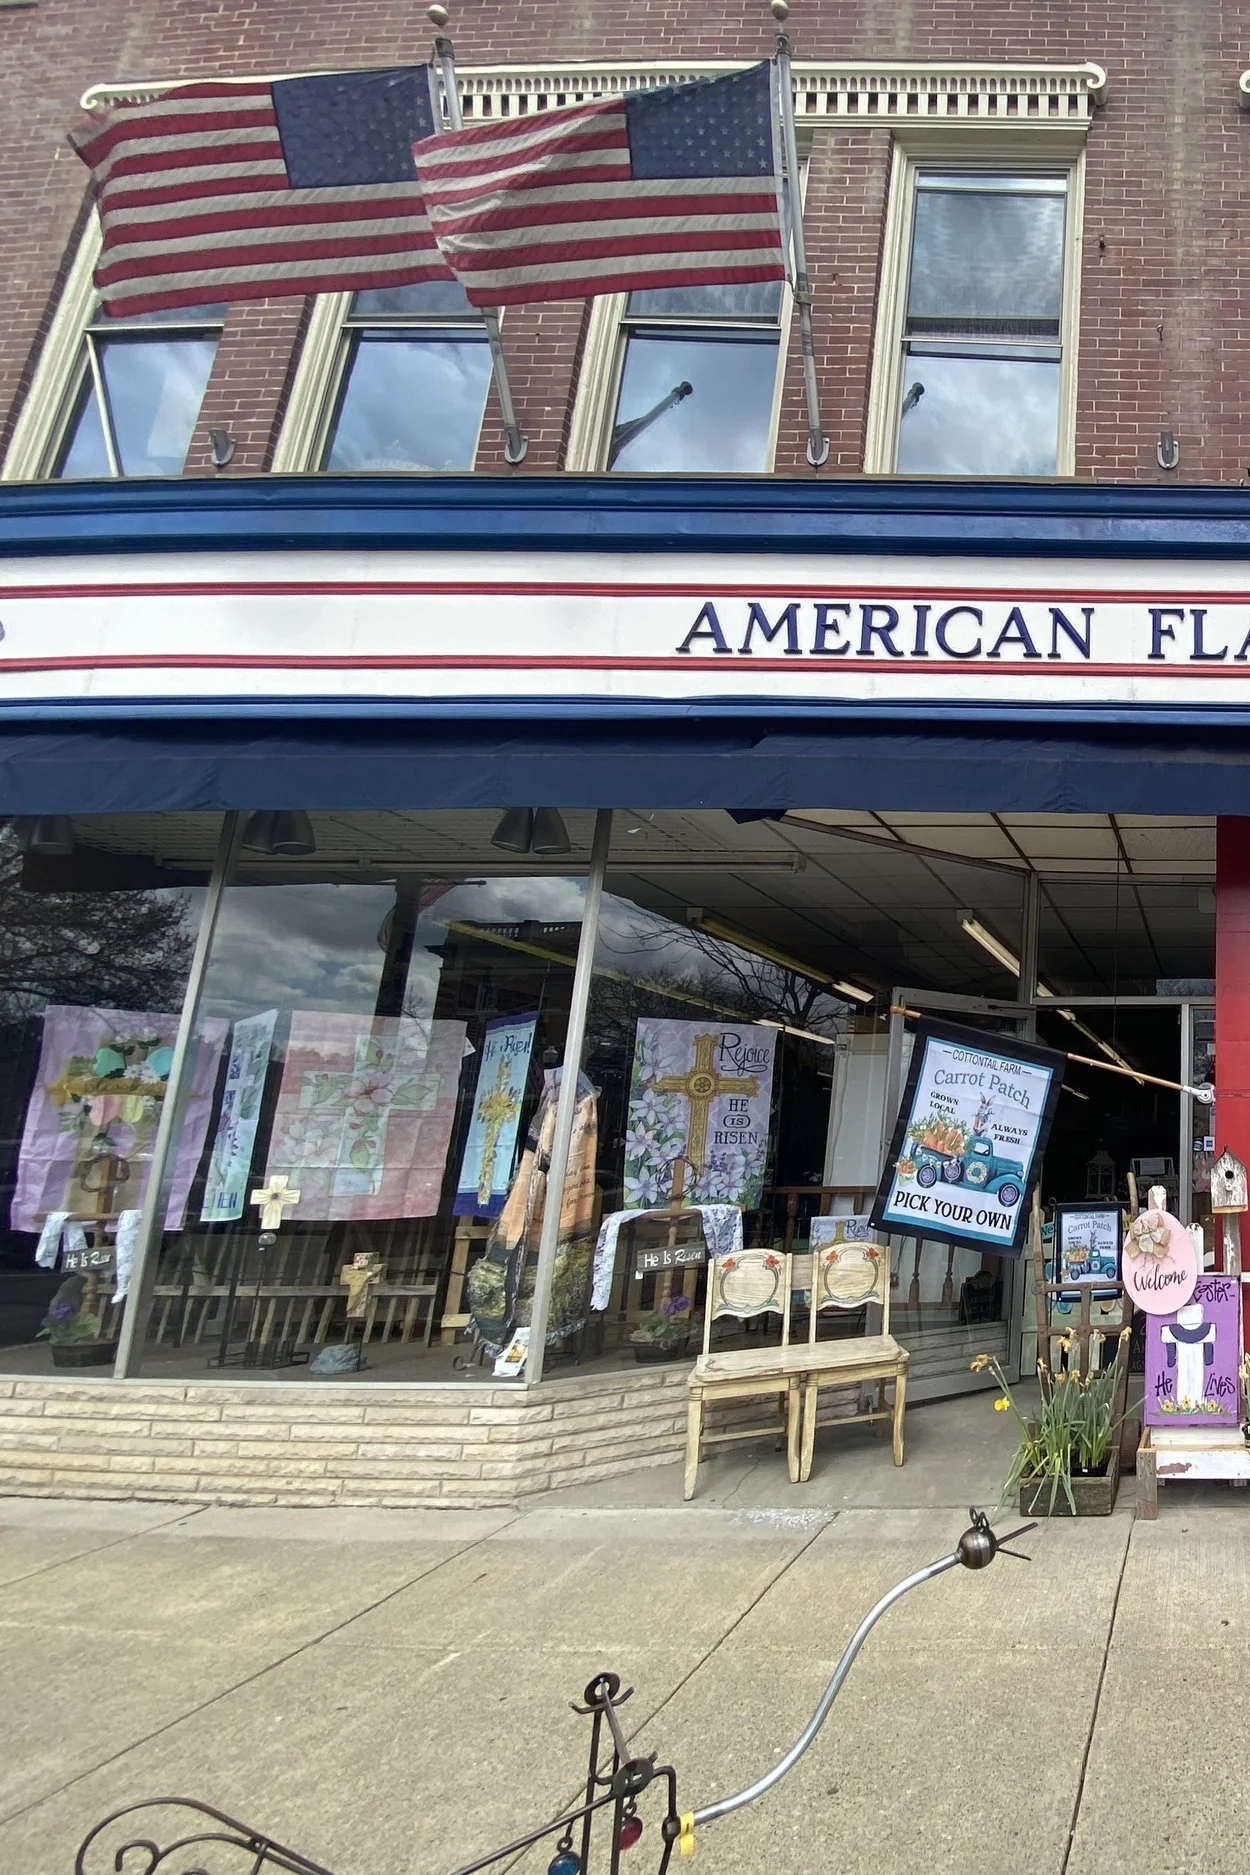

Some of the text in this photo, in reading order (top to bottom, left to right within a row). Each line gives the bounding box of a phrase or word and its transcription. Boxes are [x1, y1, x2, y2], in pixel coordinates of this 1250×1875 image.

[675, 601, 1095, 660] AMERICAN
[719, 1032, 771, 1077] Rejoice
[952, 1049, 1021, 1076] COTTONTAIL FARM
[930, 1091, 959, 1106] GROWN
[934, 1069, 1031, 1110] Carrot Patch
[729, 1098, 749, 1112] HE
[929, 1100, 956, 1115] LOCAL
[729, 1117, 744, 1126] IS
[991, 1123, 1028, 1136] ALWAYS
[714, 1130, 758, 1145] RISEN
[993, 1134, 1021, 1145] FRESH
[893, 1190, 1012, 1231] PICK YOUR OWN
[1067, 1220, 1090, 1234] Carrot
[1092, 1220, 1112, 1232] Patch
[644, 1249, 702, 1268] He Is Risen
[1133, 1263, 1188, 1292] Welcome
[1155, 1370, 1173, 1397] He
[1204, 1372, 1236, 1397] Lives
